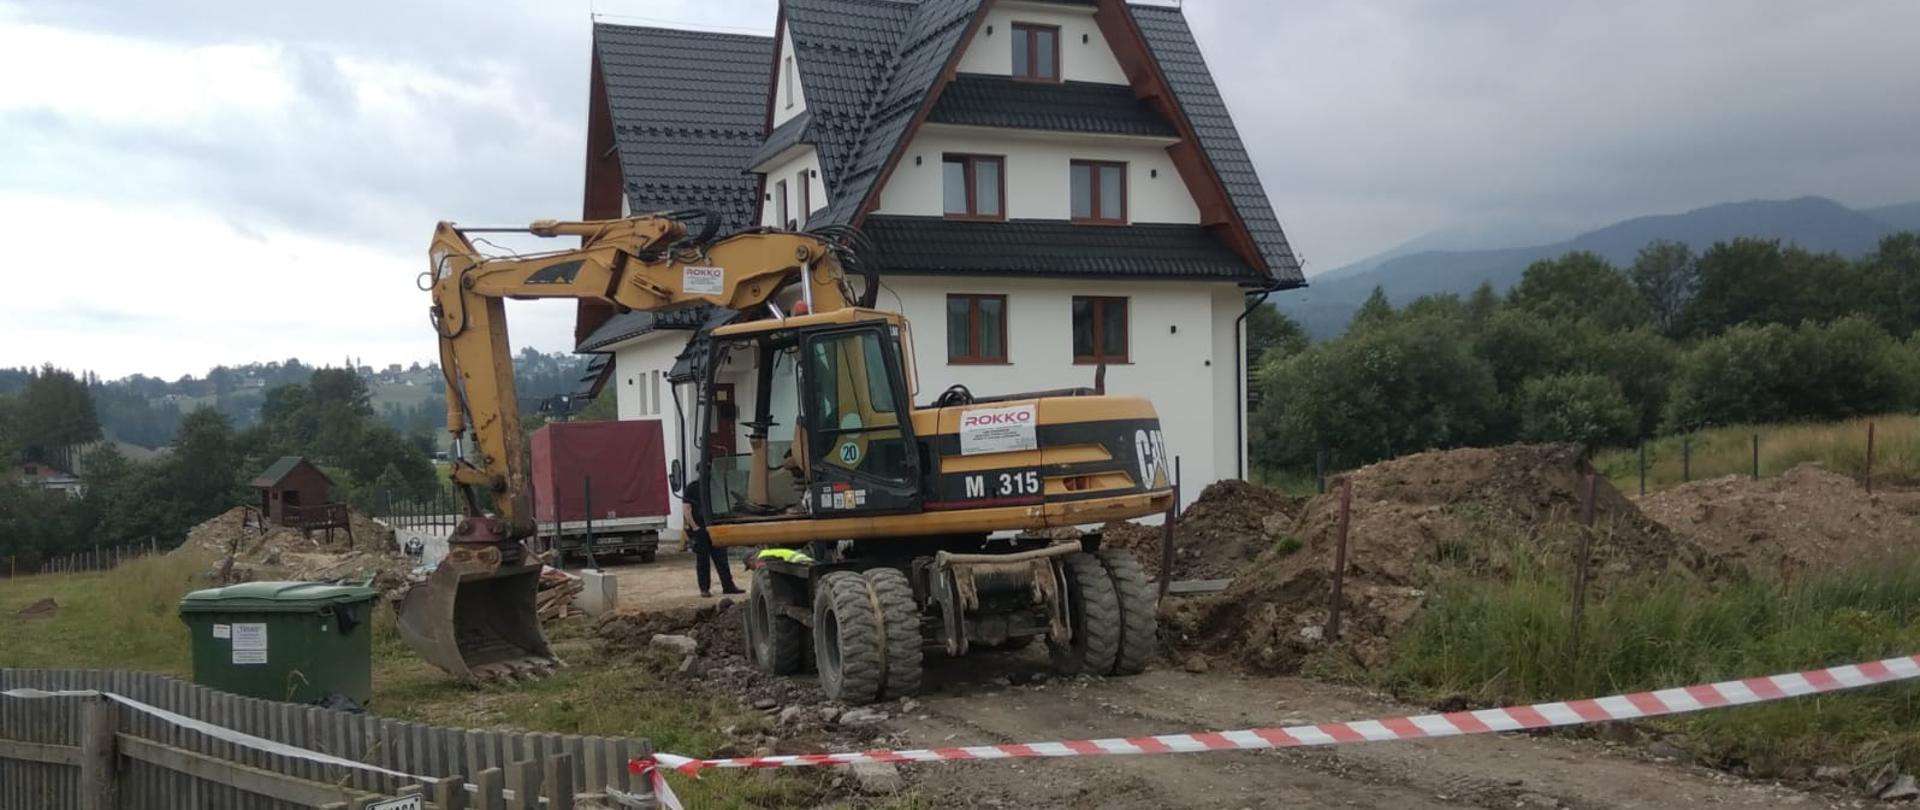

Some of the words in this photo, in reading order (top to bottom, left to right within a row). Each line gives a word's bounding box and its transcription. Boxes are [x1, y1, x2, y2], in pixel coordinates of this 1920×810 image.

[687, 269, 721, 277] ROKKO
[965, 411, 1030, 426] ROKKO
[843, 444, 857, 461] 20
[965, 475, 985, 498] M
